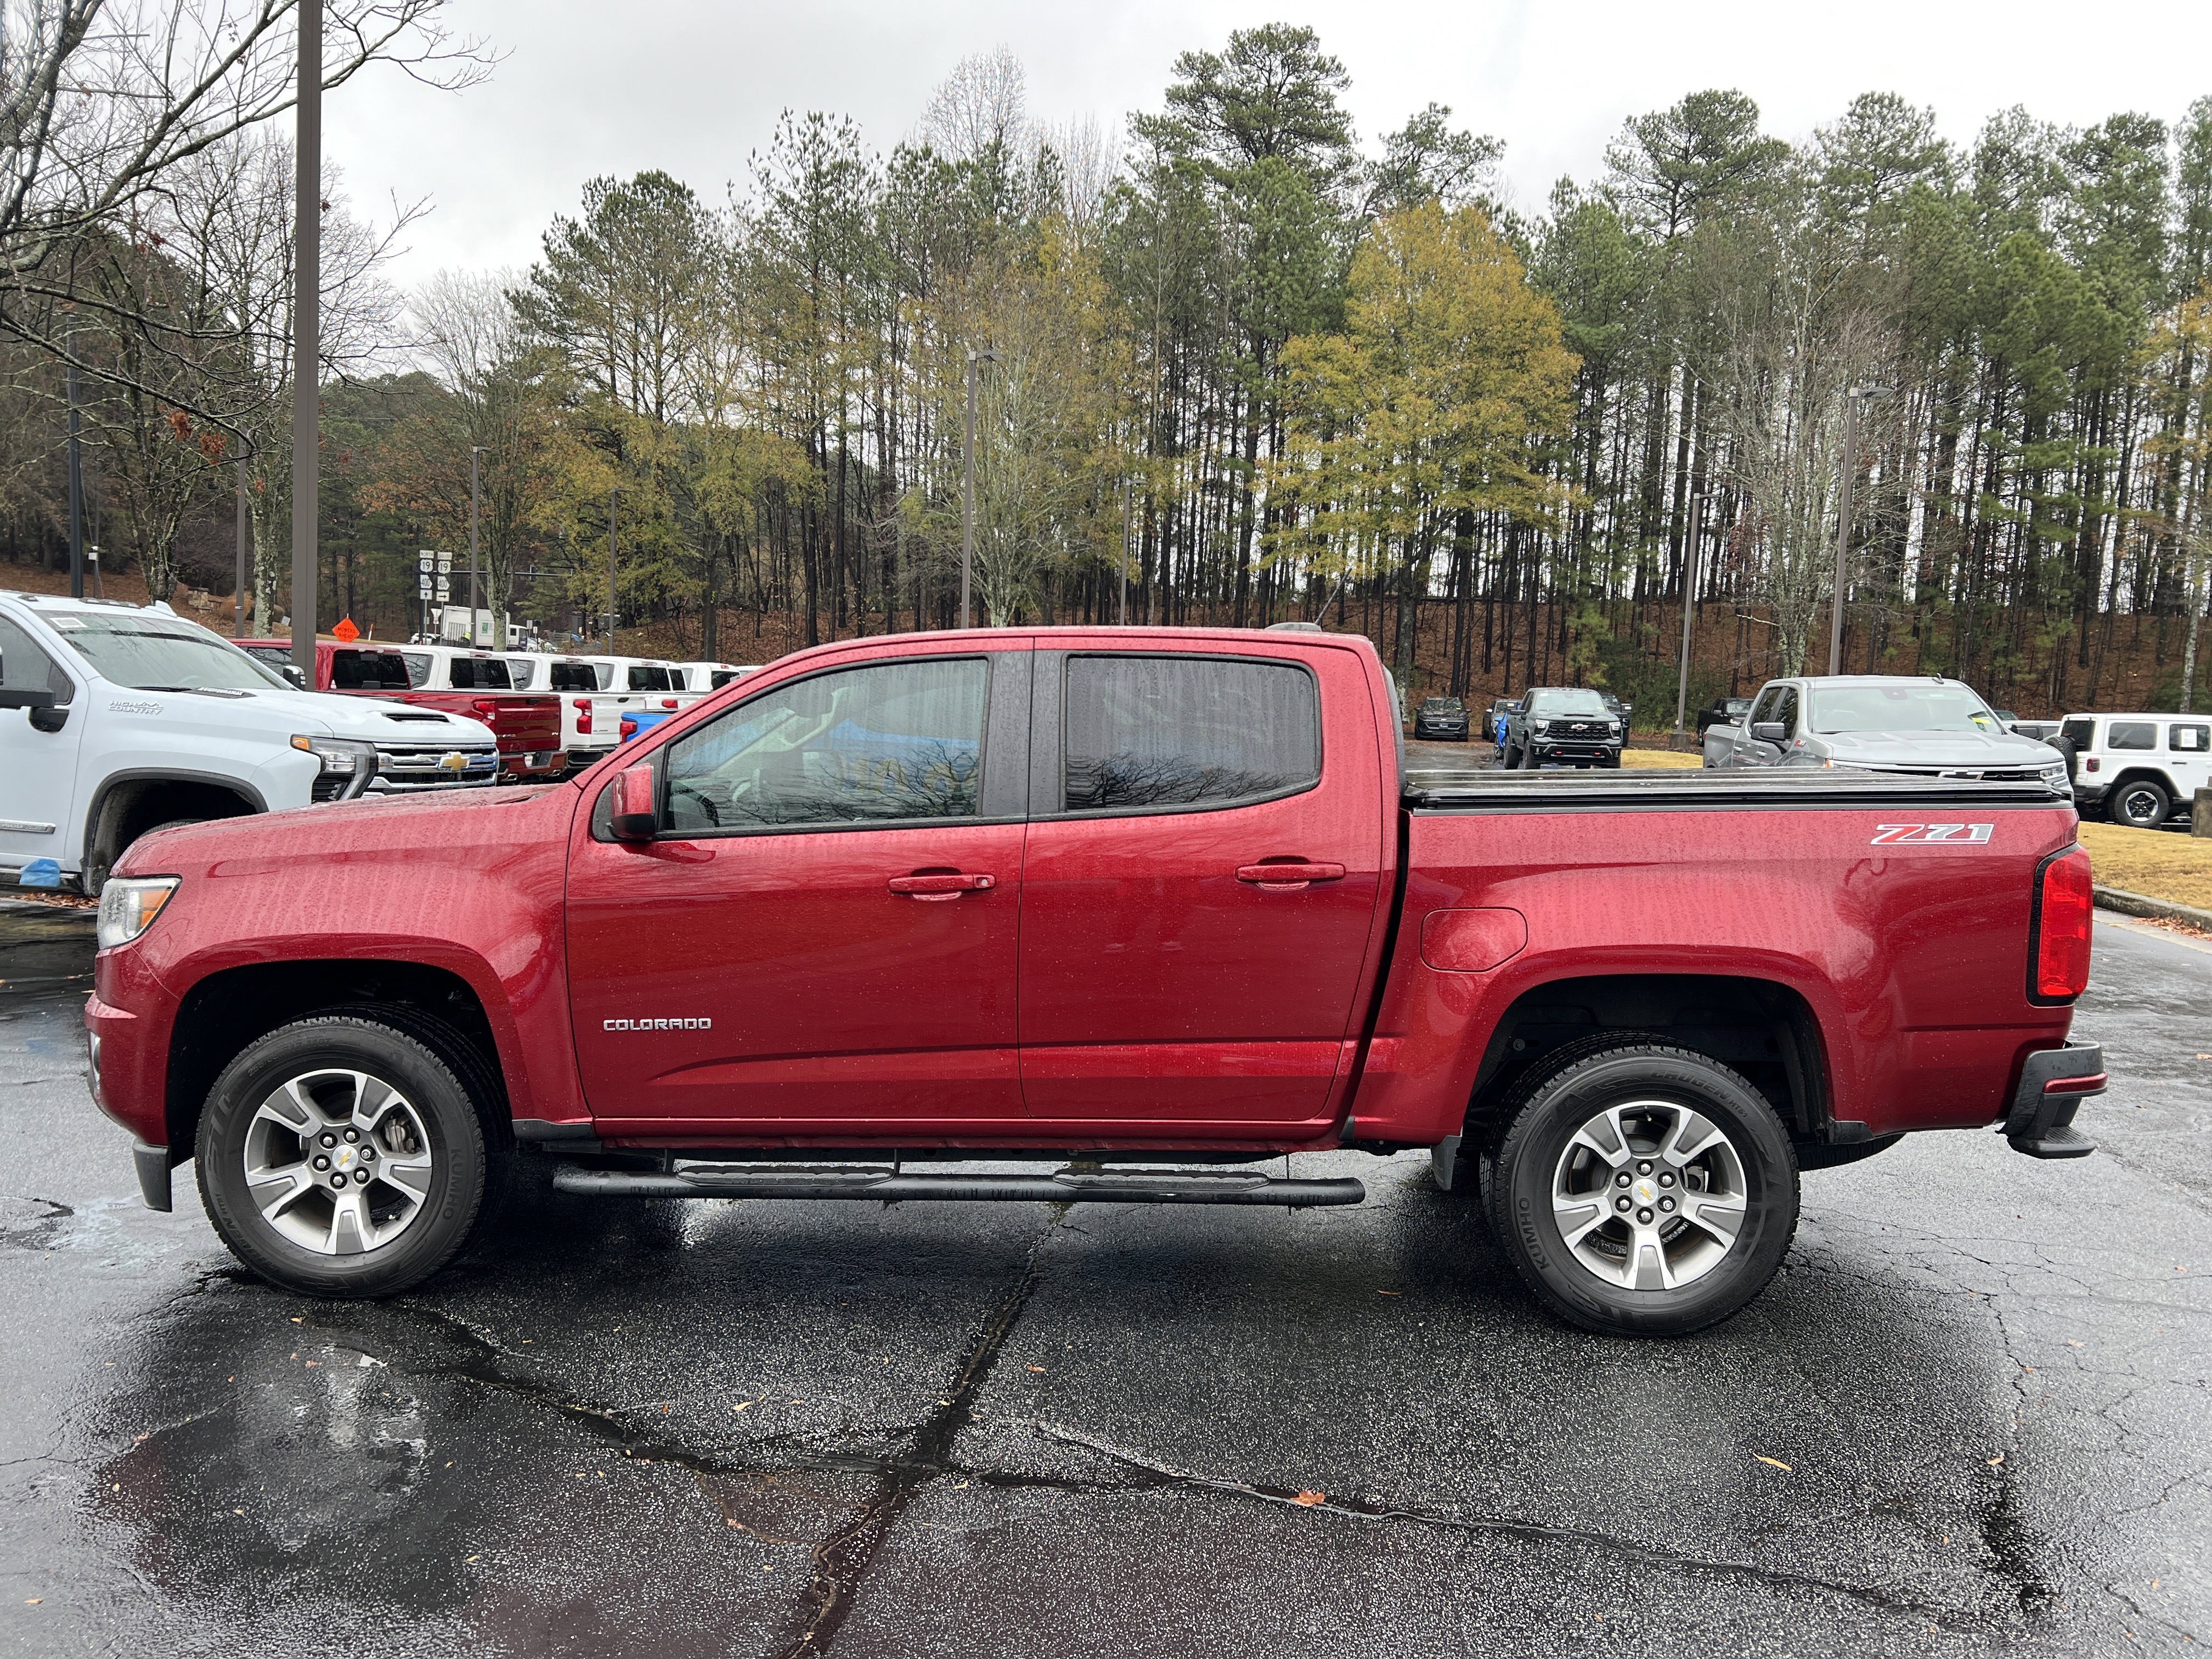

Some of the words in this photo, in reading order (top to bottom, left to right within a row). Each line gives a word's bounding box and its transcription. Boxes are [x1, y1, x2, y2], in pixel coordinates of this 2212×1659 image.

[422, 561, 431, 569] 19
[440, 563, 448, 571] 19
[421, 578, 430, 586] 400
[438, 579, 447, 588] 400
[108, 706, 162, 715] COUNTRY
[1870, 823, 1995, 845] Z71
[603, 1018, 712, 1031] COLORADO
[1651, 1070, 1730, 1100] CRUGEN
[1729, 1099, 1748, 1118] HT51
[443, 1148, 462, 1220] KUMHO
[1519, 1197, 1550, 1270] KUMHO
